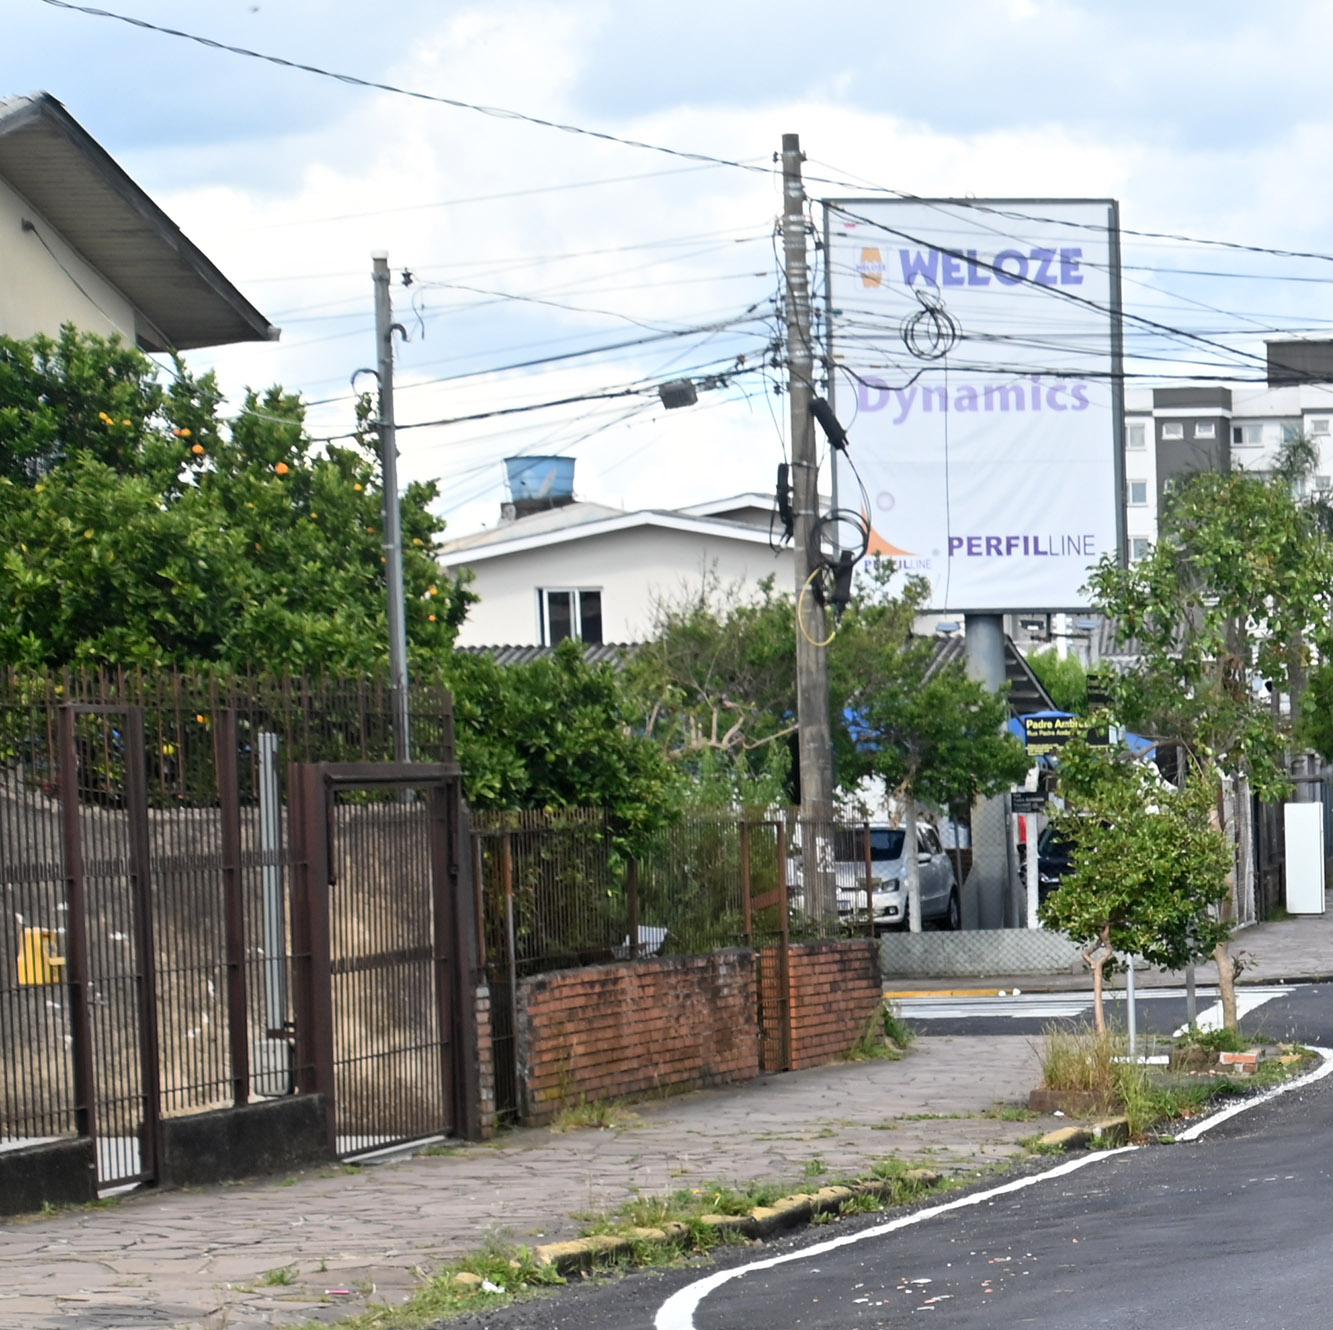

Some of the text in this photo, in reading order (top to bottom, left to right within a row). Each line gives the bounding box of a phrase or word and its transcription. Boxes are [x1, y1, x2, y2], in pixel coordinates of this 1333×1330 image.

[899, 247, 1084, 288] WELOZE
[857, 373, 1090, 425] Dynamics
[1026, 719, 1053, 729] Padre
